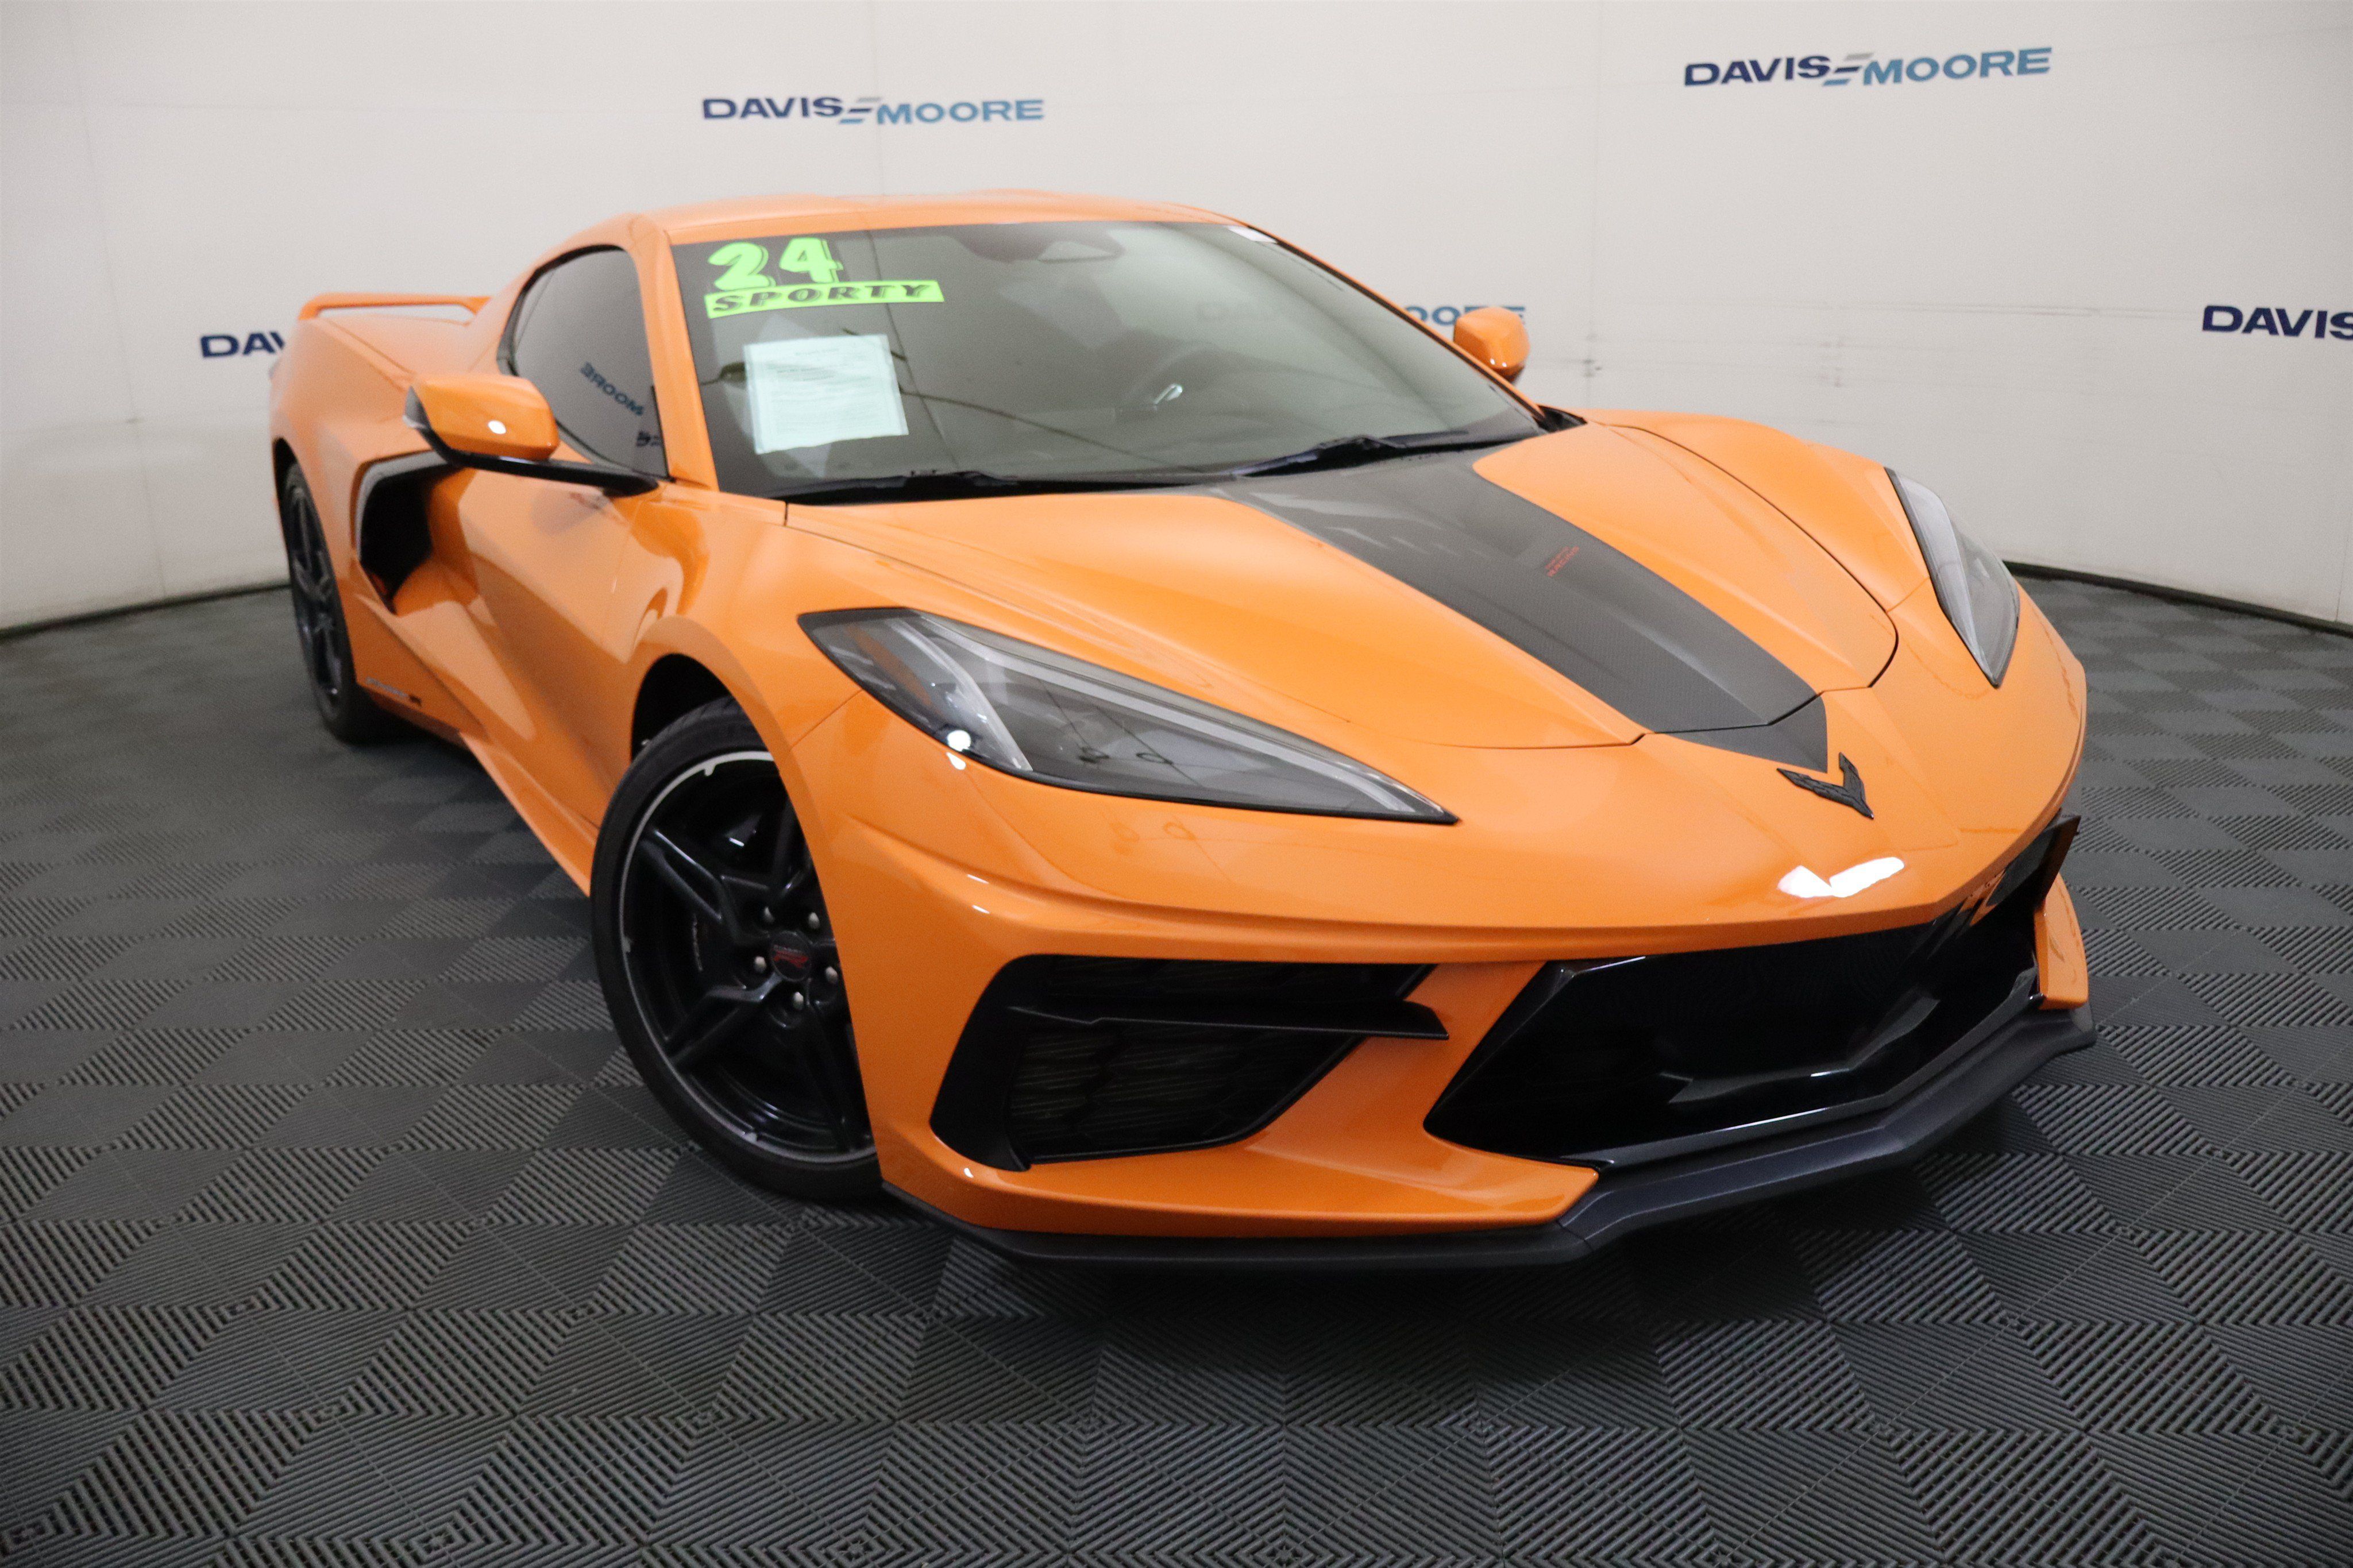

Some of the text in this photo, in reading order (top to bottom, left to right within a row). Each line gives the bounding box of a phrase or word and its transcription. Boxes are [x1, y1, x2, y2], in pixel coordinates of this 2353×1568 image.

[1684, 47, 2053, 87] DAVIS MOORE
[702, 96, 1044, 125] DAVIS MOORE
[707, 237, 844, 291] 24
[712, 284, 932, 313] SPORTY
